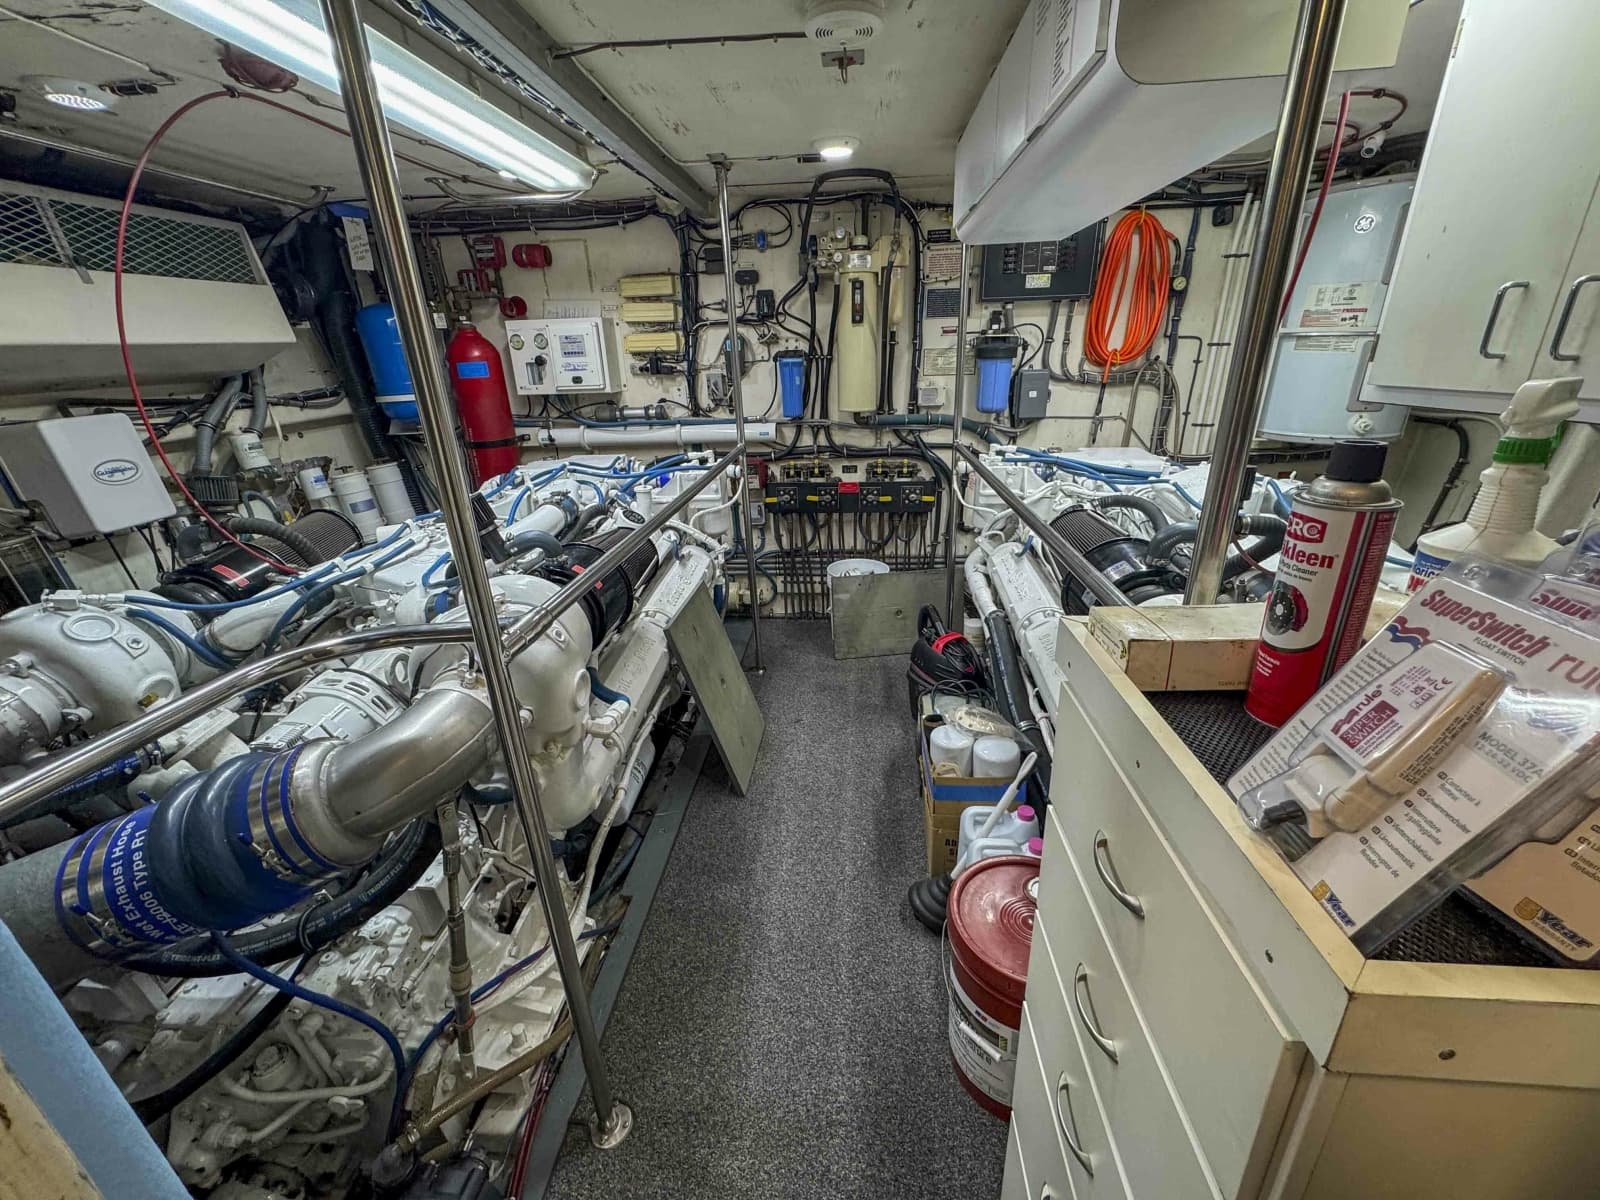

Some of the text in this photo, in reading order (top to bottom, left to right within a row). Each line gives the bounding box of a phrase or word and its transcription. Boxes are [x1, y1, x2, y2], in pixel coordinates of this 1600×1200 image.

[1420, 589, 1551, 658] SuperSwitch
[1495, 648, 1527, 666] SWITCH
[1356, 689, 1382, 714] rule
[1343, 710, 1378, 740] SUPER
[1350, 709, 1392, 746] SWITCH
[1478, 731, 1518, 762] MODEL
[111, 820, 137, 858] Hose
[131, 829, 148, 849] R1
[133, 851, 148, 890] Type
[110, 860, 142, 921] Exhaust
